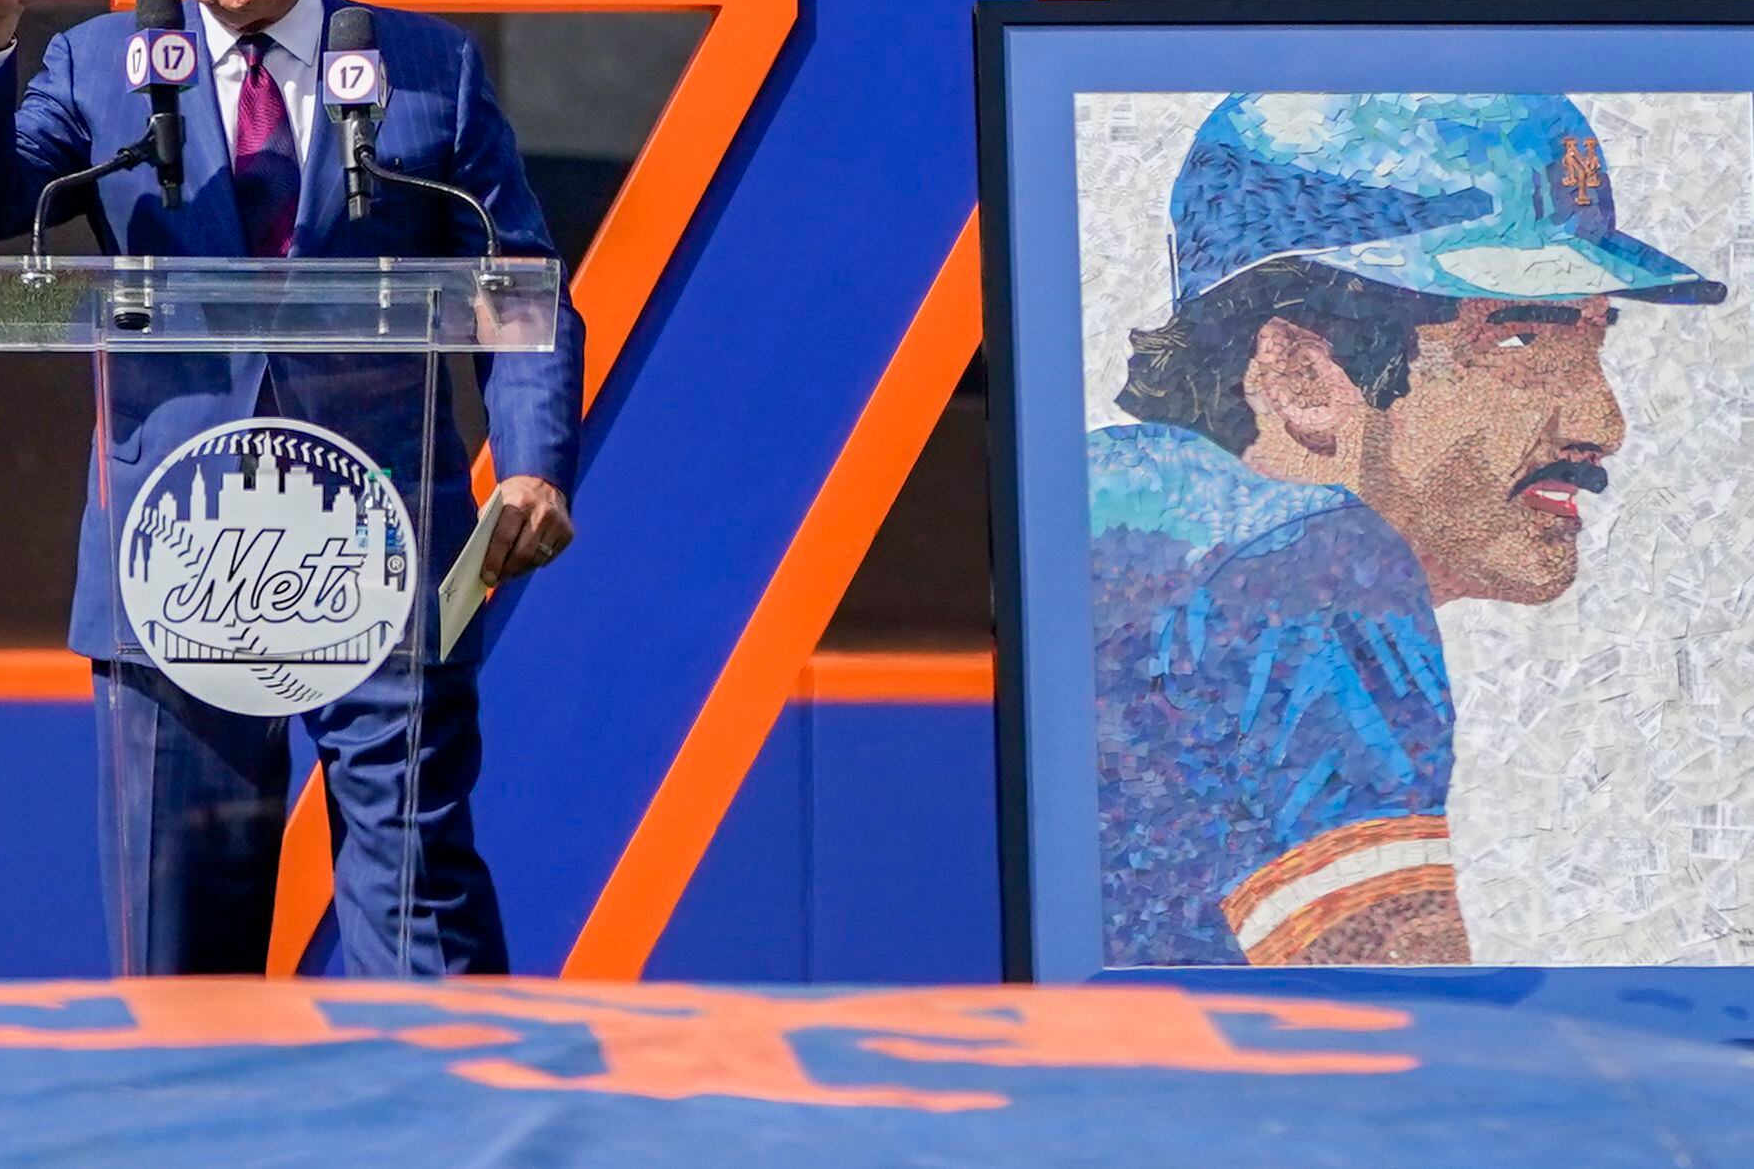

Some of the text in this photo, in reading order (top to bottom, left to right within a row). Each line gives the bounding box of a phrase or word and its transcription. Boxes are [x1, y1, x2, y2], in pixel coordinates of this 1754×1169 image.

[161, 44, 185, 70] 17
[340, 65, 365, 89] 17
[162, 528, 368, 624] Mets
